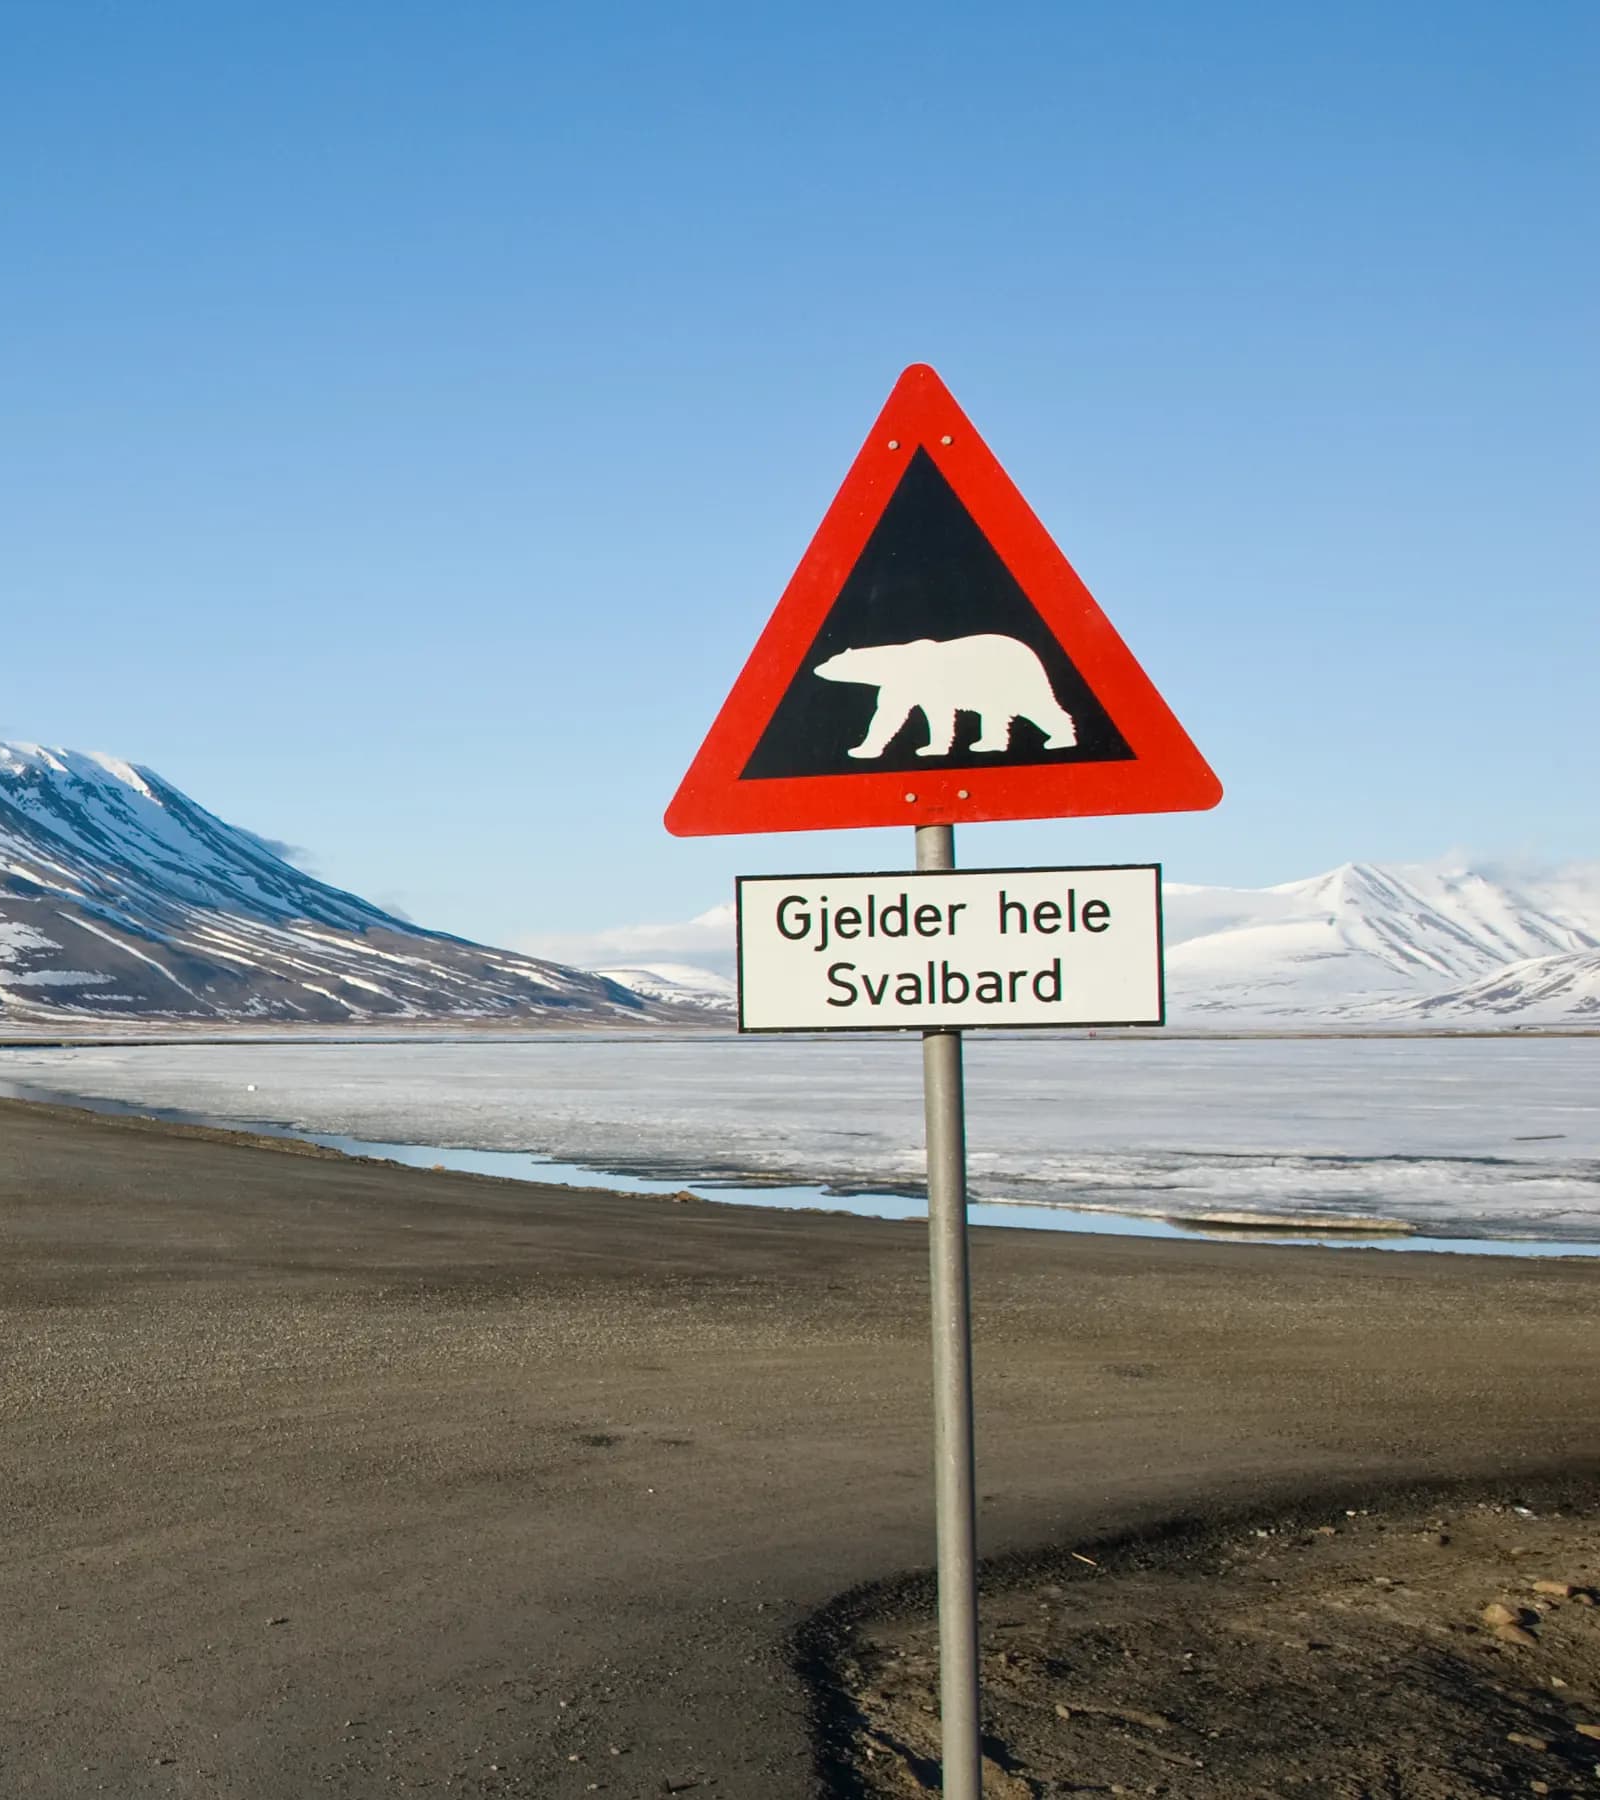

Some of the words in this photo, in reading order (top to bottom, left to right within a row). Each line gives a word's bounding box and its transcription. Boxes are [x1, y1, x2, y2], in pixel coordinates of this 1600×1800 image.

[776, 893, 967, 952] Gjelder
[999, 888, 1111, 935] hele
[826, 957, 1062, 1007] Svalbard
